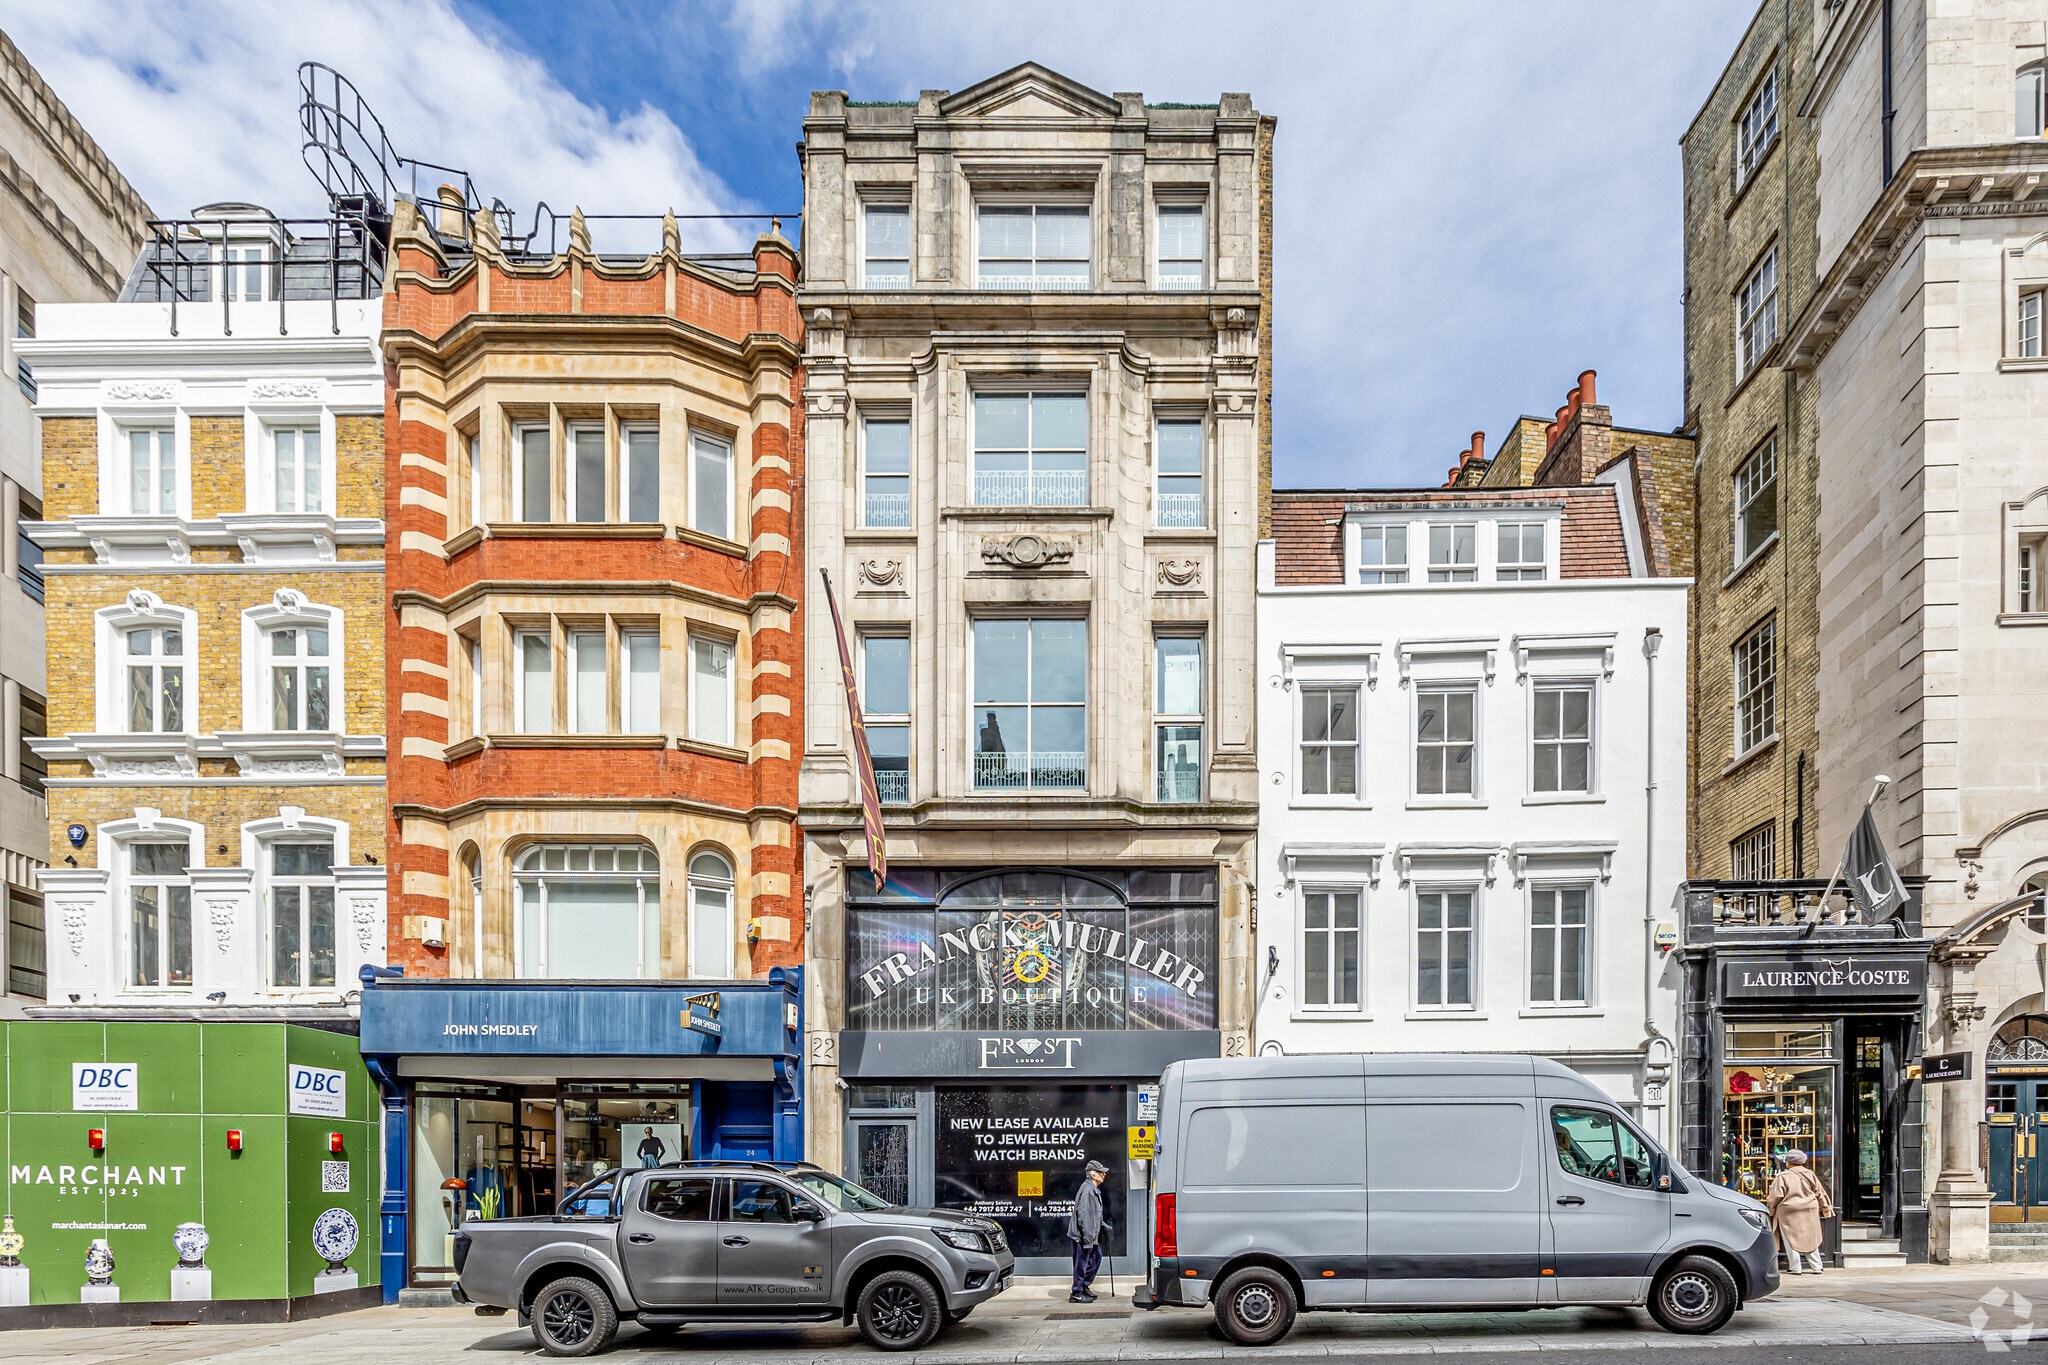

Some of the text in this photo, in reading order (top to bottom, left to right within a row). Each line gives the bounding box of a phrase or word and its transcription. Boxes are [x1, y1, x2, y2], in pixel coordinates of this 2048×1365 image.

[859, 919, 1205, 999] FRANCK MULLER
[1743, 970, 1910, 987] LAURENCE COSTE
[979, 987, 1147, 1008] BOUTIQUE
[442, 1024, 538, 1036] JOHN SMEDLEY
[690, 1016, 720, 1032] JOHN SMEDLEY
[813, 1037, 835, 1058] 22
[1227, 1036, 1246, 1057] 22
[78, 1068, 132, 1088] DBC
[295, 1070, 341, 1093] DBC
[1648, 1088, 1661, 1100] 20
[951, 1117, 1109, 1129] NEW LEASE AVAILABLE
[974, 1132, 1085, 1146] TO JEWELLERY/
[974, 1149, 1085, 1161] WATCH BRANDS
[11, 1165, 186, 1185] MARCHANT
[98, 1187, 138, 1197] 1925
[1020, 1186, 1042, 1194] savills
[52, 1221, 147, 1230] marchantasianart.com
[724, 1283, 824, 1295] www.ATK-Group.co.uk
